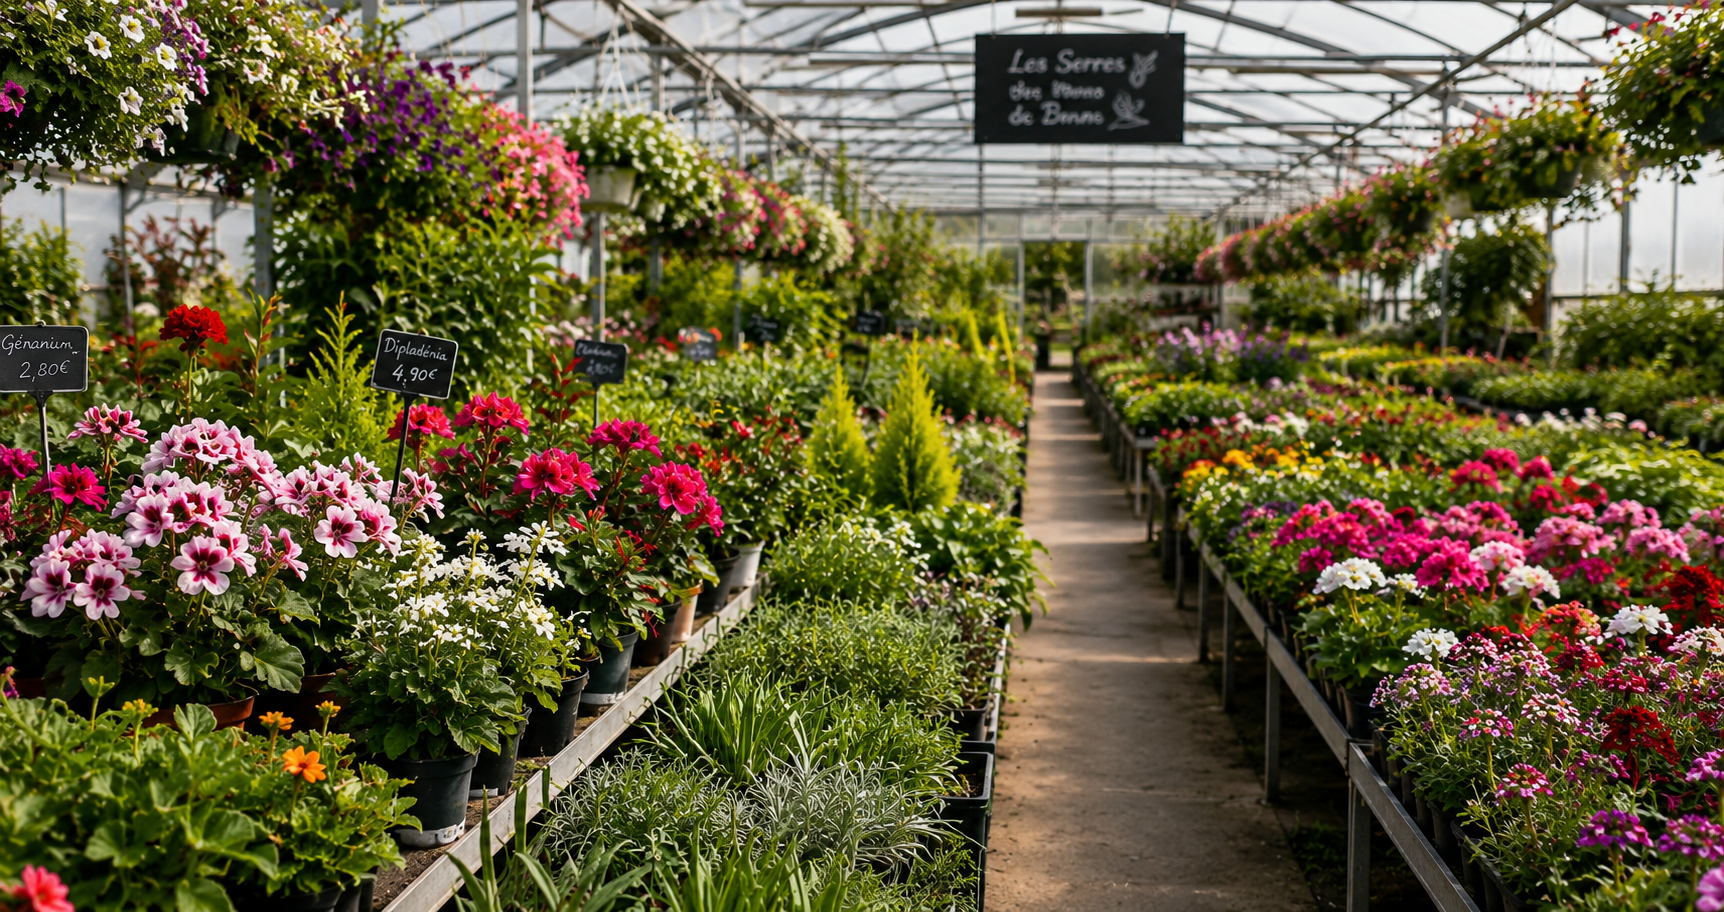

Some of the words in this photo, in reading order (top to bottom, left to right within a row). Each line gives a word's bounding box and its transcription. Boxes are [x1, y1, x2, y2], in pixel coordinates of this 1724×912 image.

[1007, 48, 1049, 74] Les
[1054, 48, 1126, 74] Serres
[1008, 104, 1035, 126] de
[384, 337, 448, 361] Dipladénia
[19, 360, 71, 382] 2,80€
